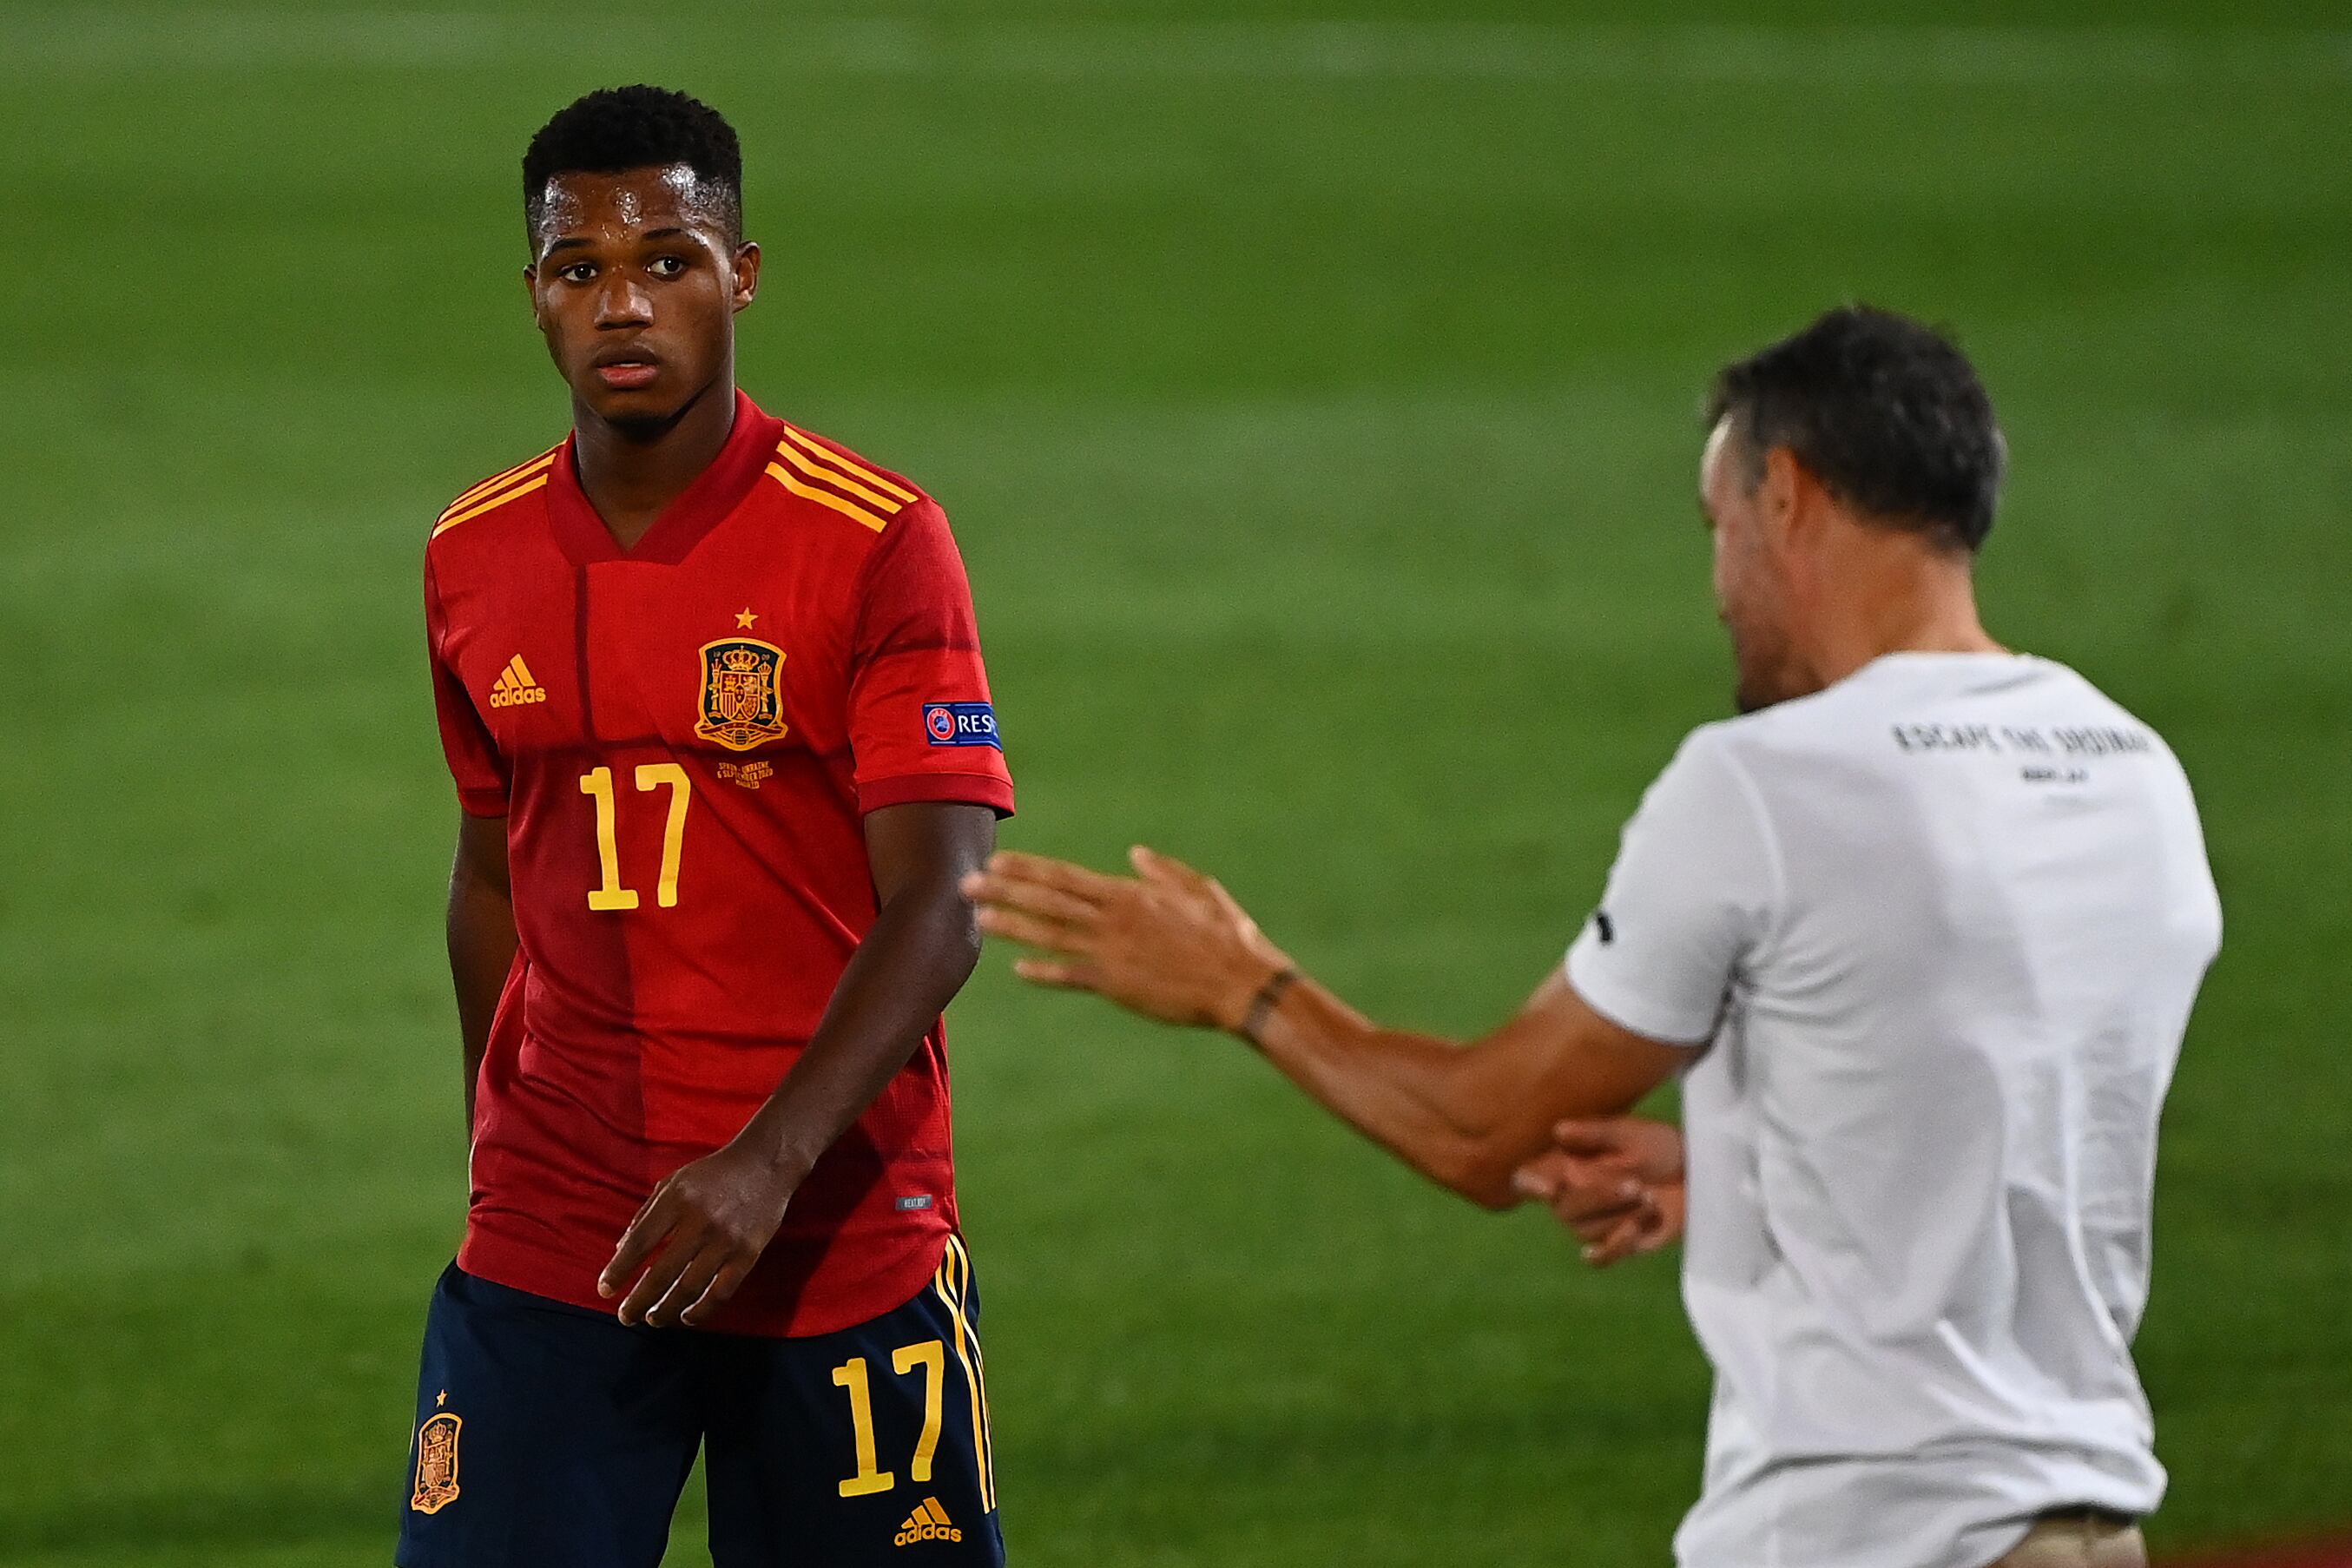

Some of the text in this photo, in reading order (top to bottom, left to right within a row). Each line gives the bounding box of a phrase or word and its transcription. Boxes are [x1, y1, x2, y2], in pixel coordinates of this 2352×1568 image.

[490, 687, 546, 708] adidas
[579, 763, 691, 910] 17
[832, 1340, 945, 1498] 17
[894, 1523, 962, 1547] adidas
